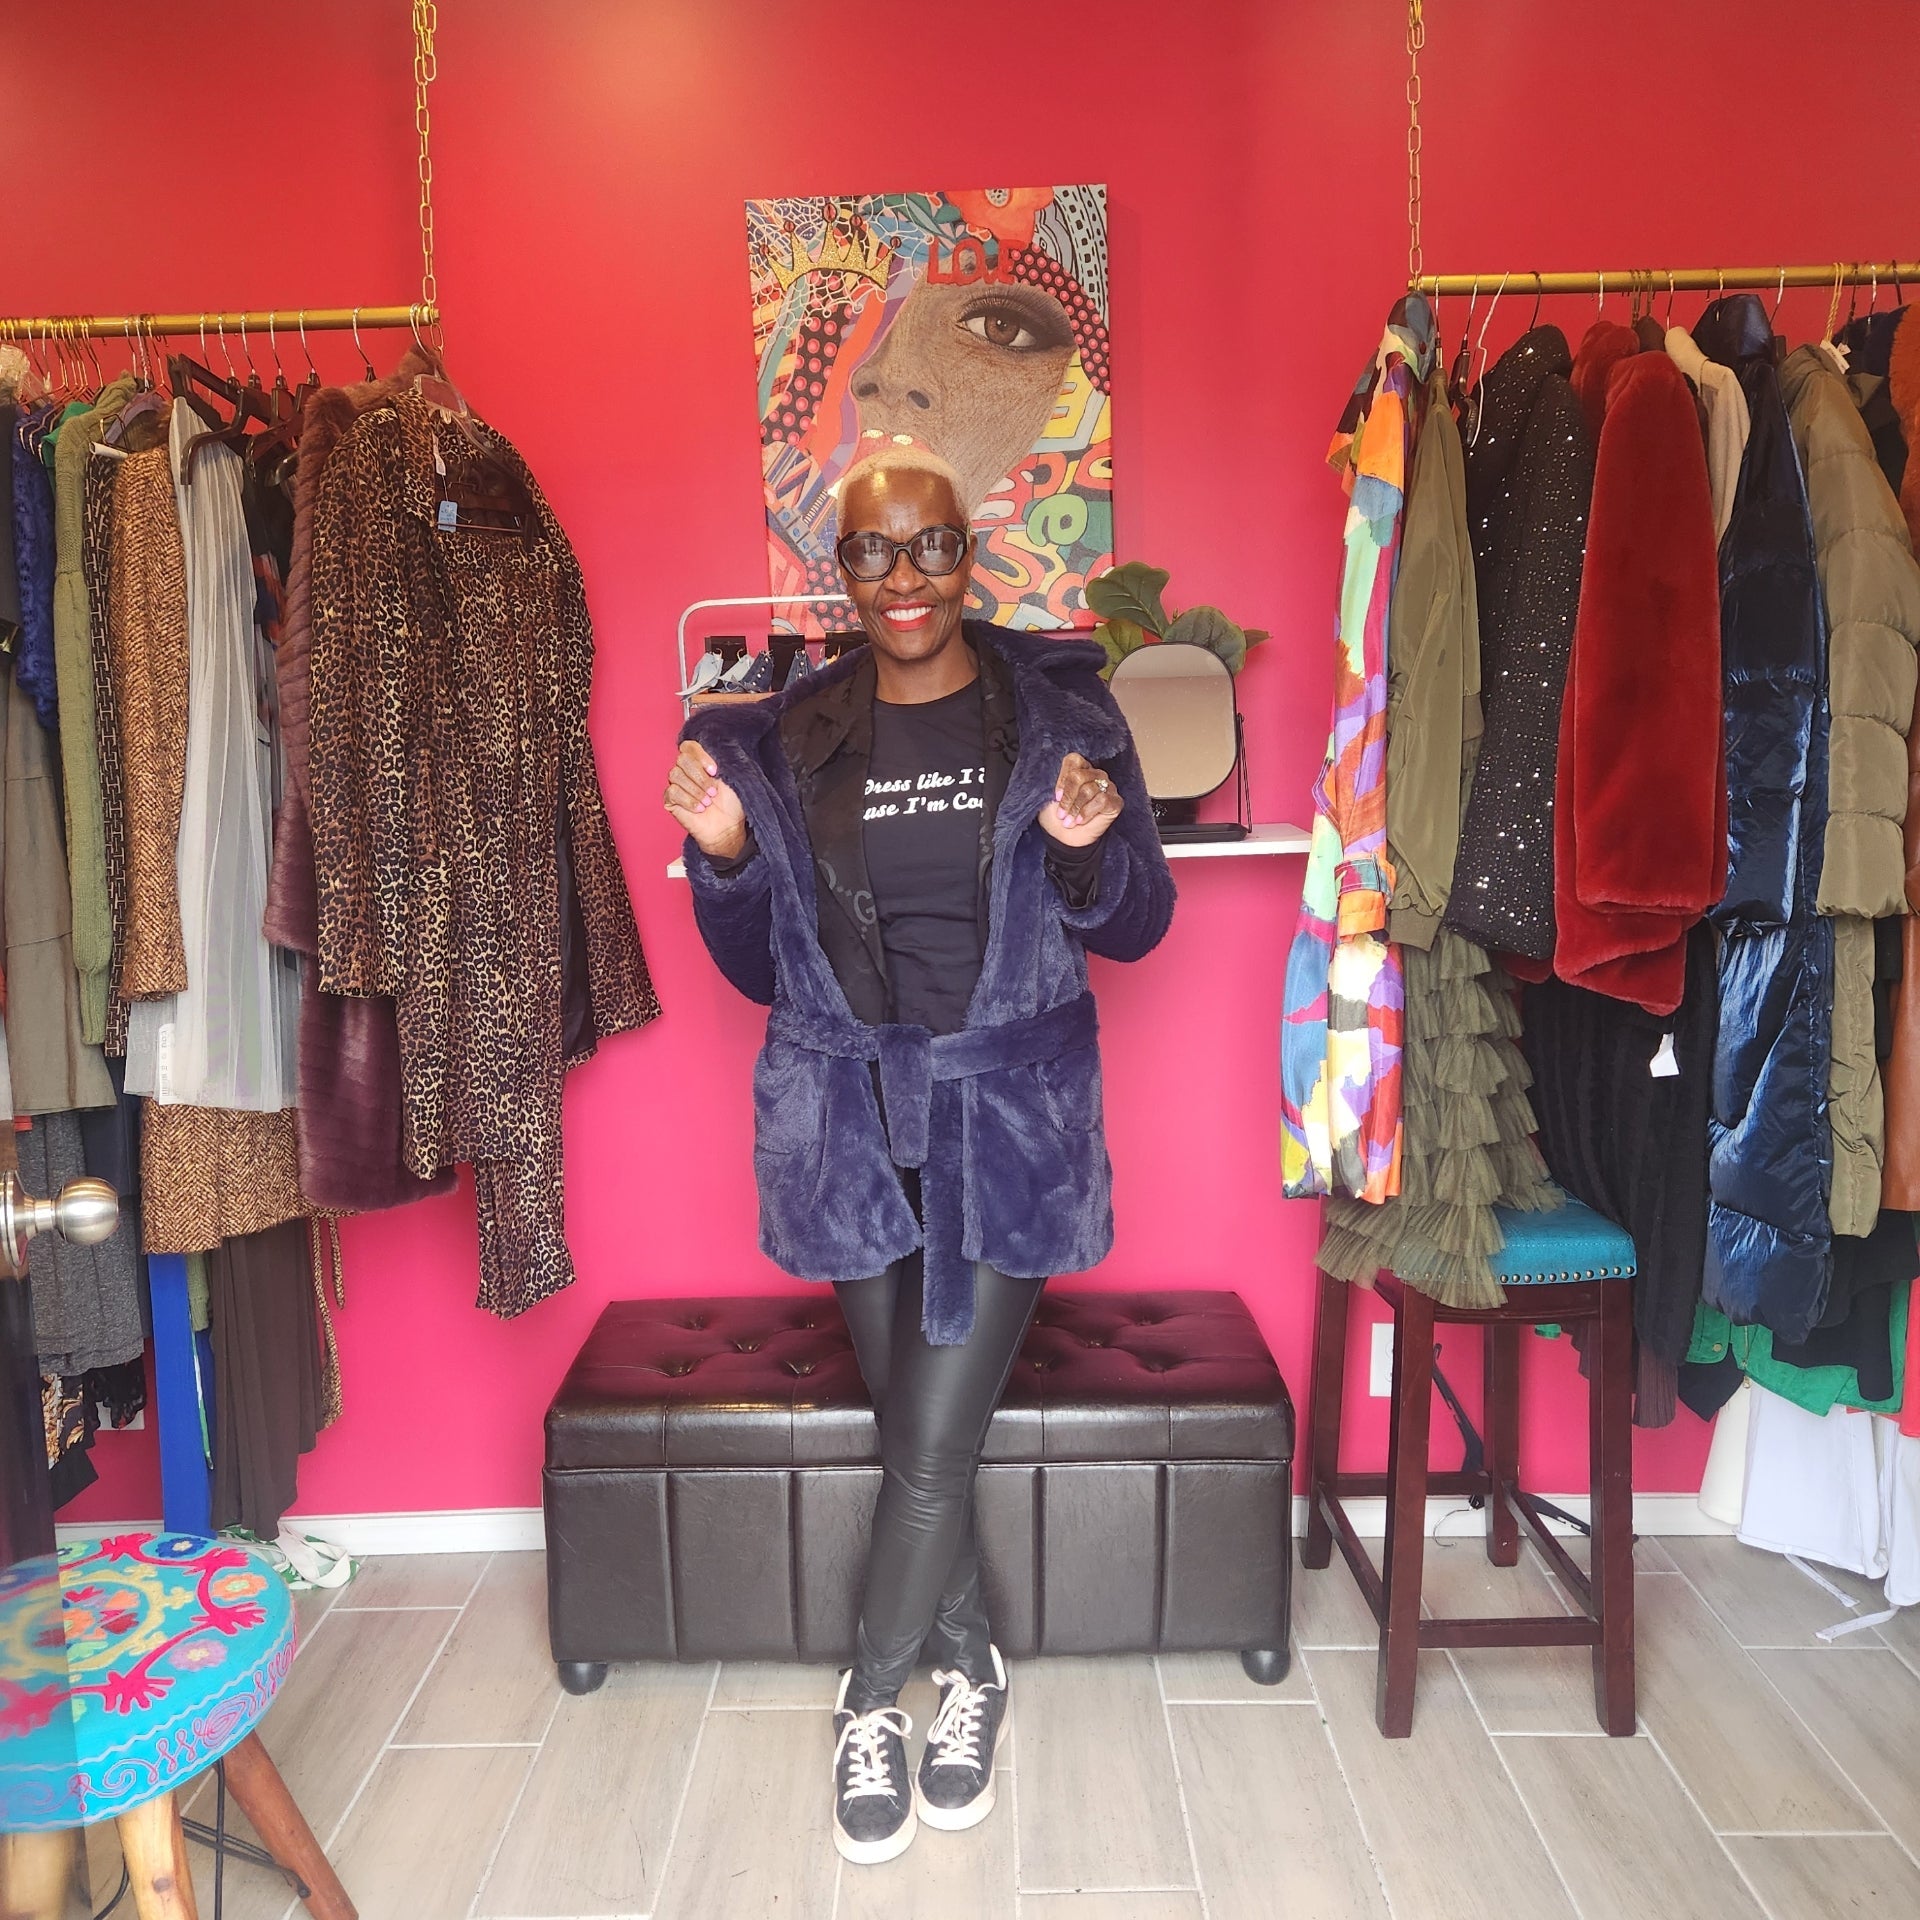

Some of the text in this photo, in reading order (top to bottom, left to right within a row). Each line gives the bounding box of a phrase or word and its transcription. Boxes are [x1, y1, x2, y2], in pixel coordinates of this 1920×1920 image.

[916, 771, 956, 791] like
[958, 768, 974, 785] I
[903, 796, 949, 815] I'm
